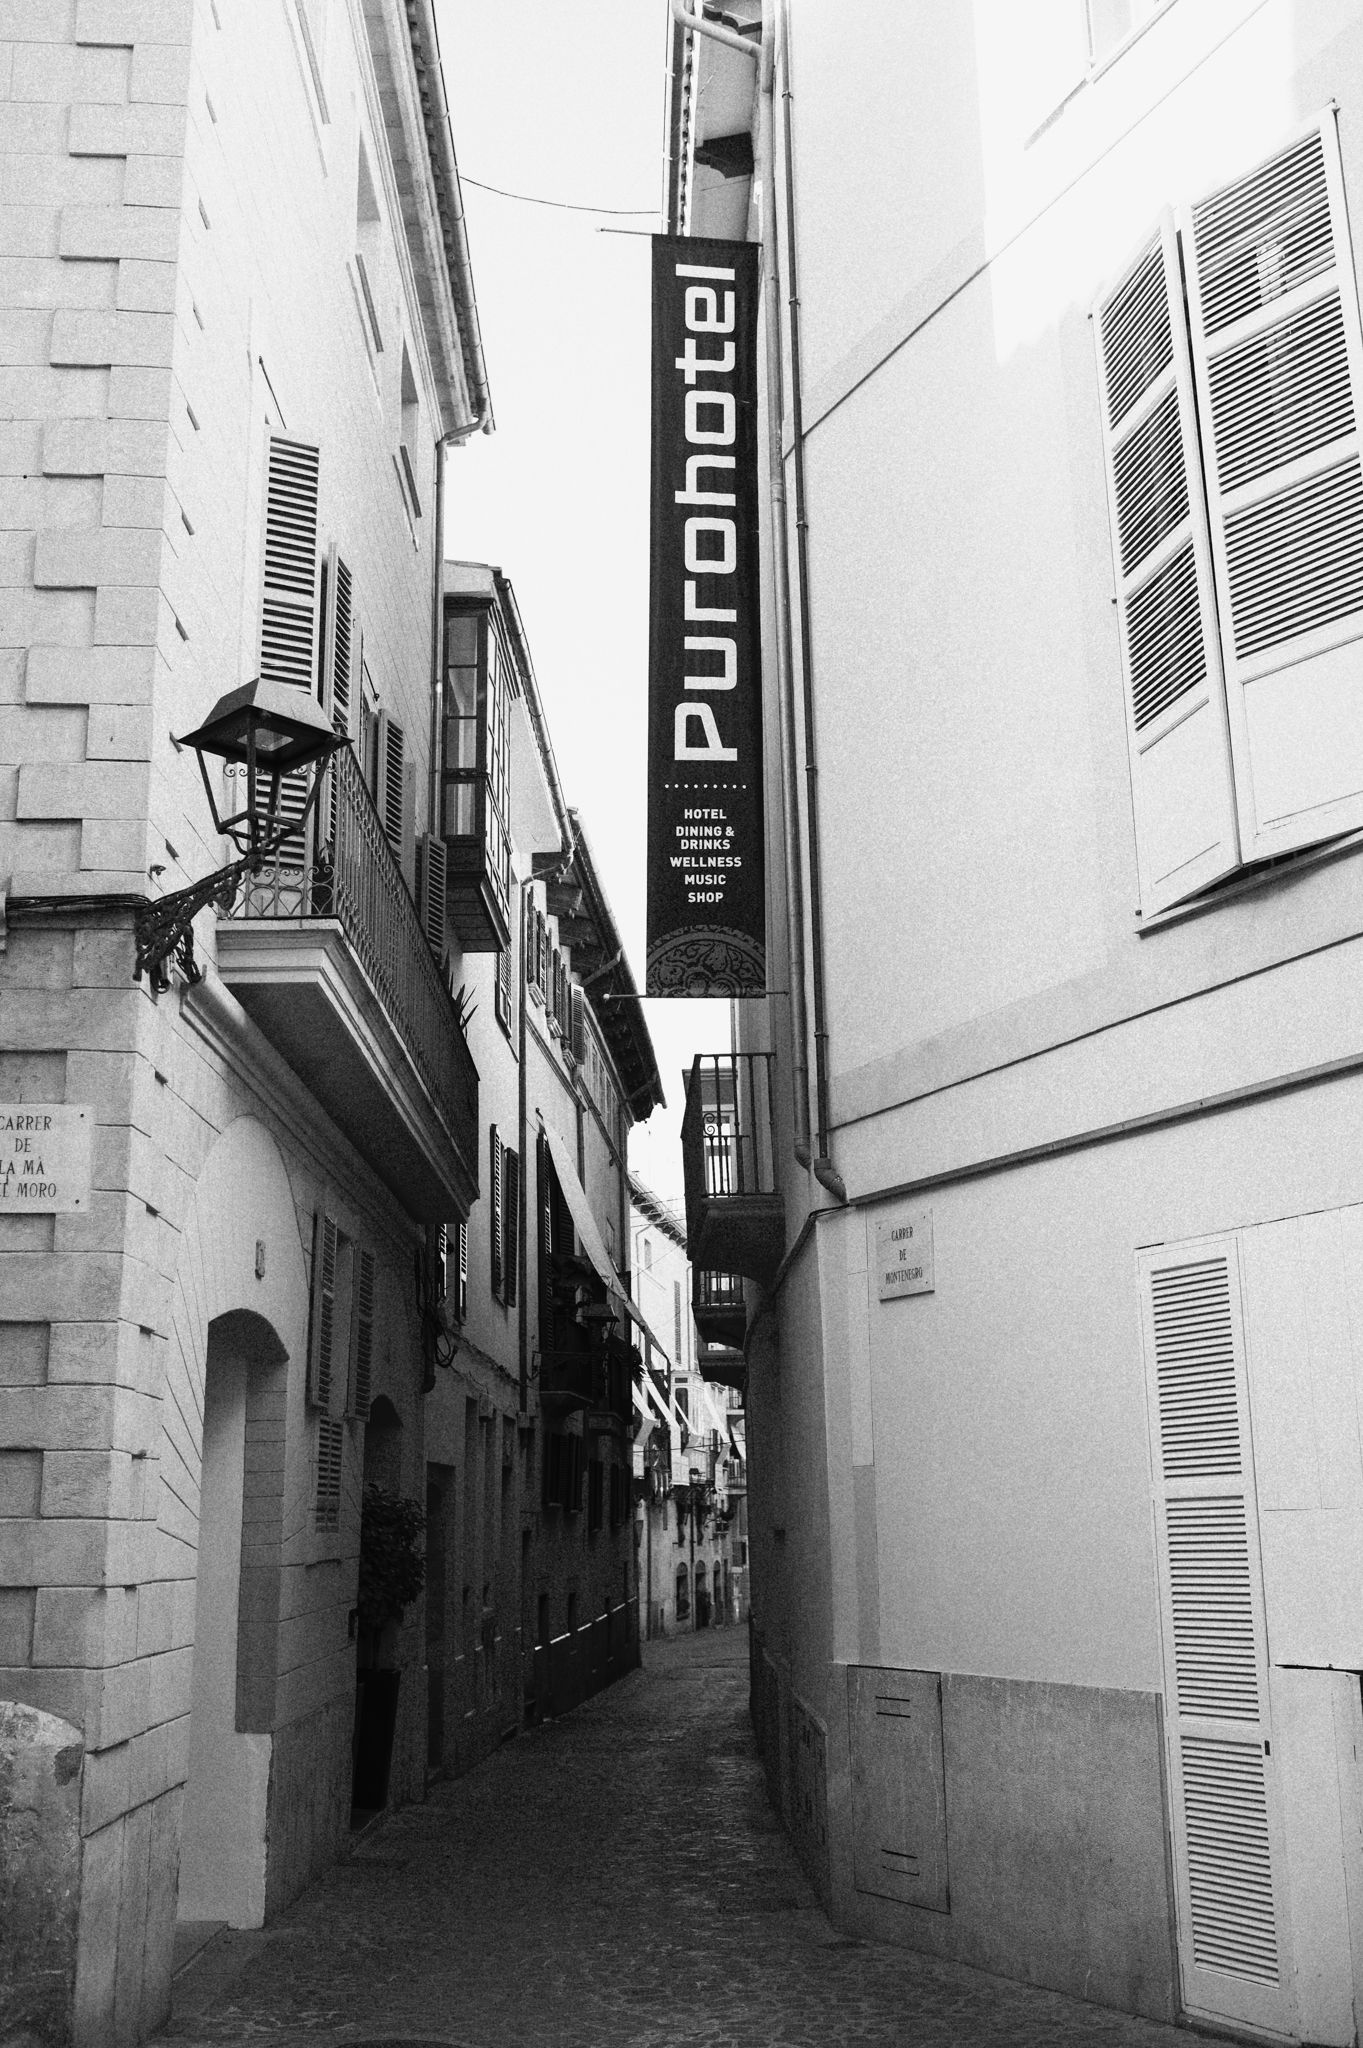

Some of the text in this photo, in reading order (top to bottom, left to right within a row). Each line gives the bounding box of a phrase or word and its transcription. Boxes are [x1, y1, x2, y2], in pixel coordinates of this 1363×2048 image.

[674, 263, 738, 762] Purohotel
[684, 808, 727, 819] HOTEL
[675, 826, 735, 837] DINING &
[680, 839, 731, 850] DRINKS
[669, 856, 742, 867] WELLNESS
[684, 874, 727, 885] MUSIC
[687, 892, 724, 903] SHOP
[14, 1137, 32, 1153] DE
[0, 1160, 15, 1175] LA
[16, 1182, 57, 1198] MORO
[891, 1226, 914, 1242] CARRER
[899, 1248, 907, 1261] DE
[885, 1266, 923, 1285] MONTENEGRO
